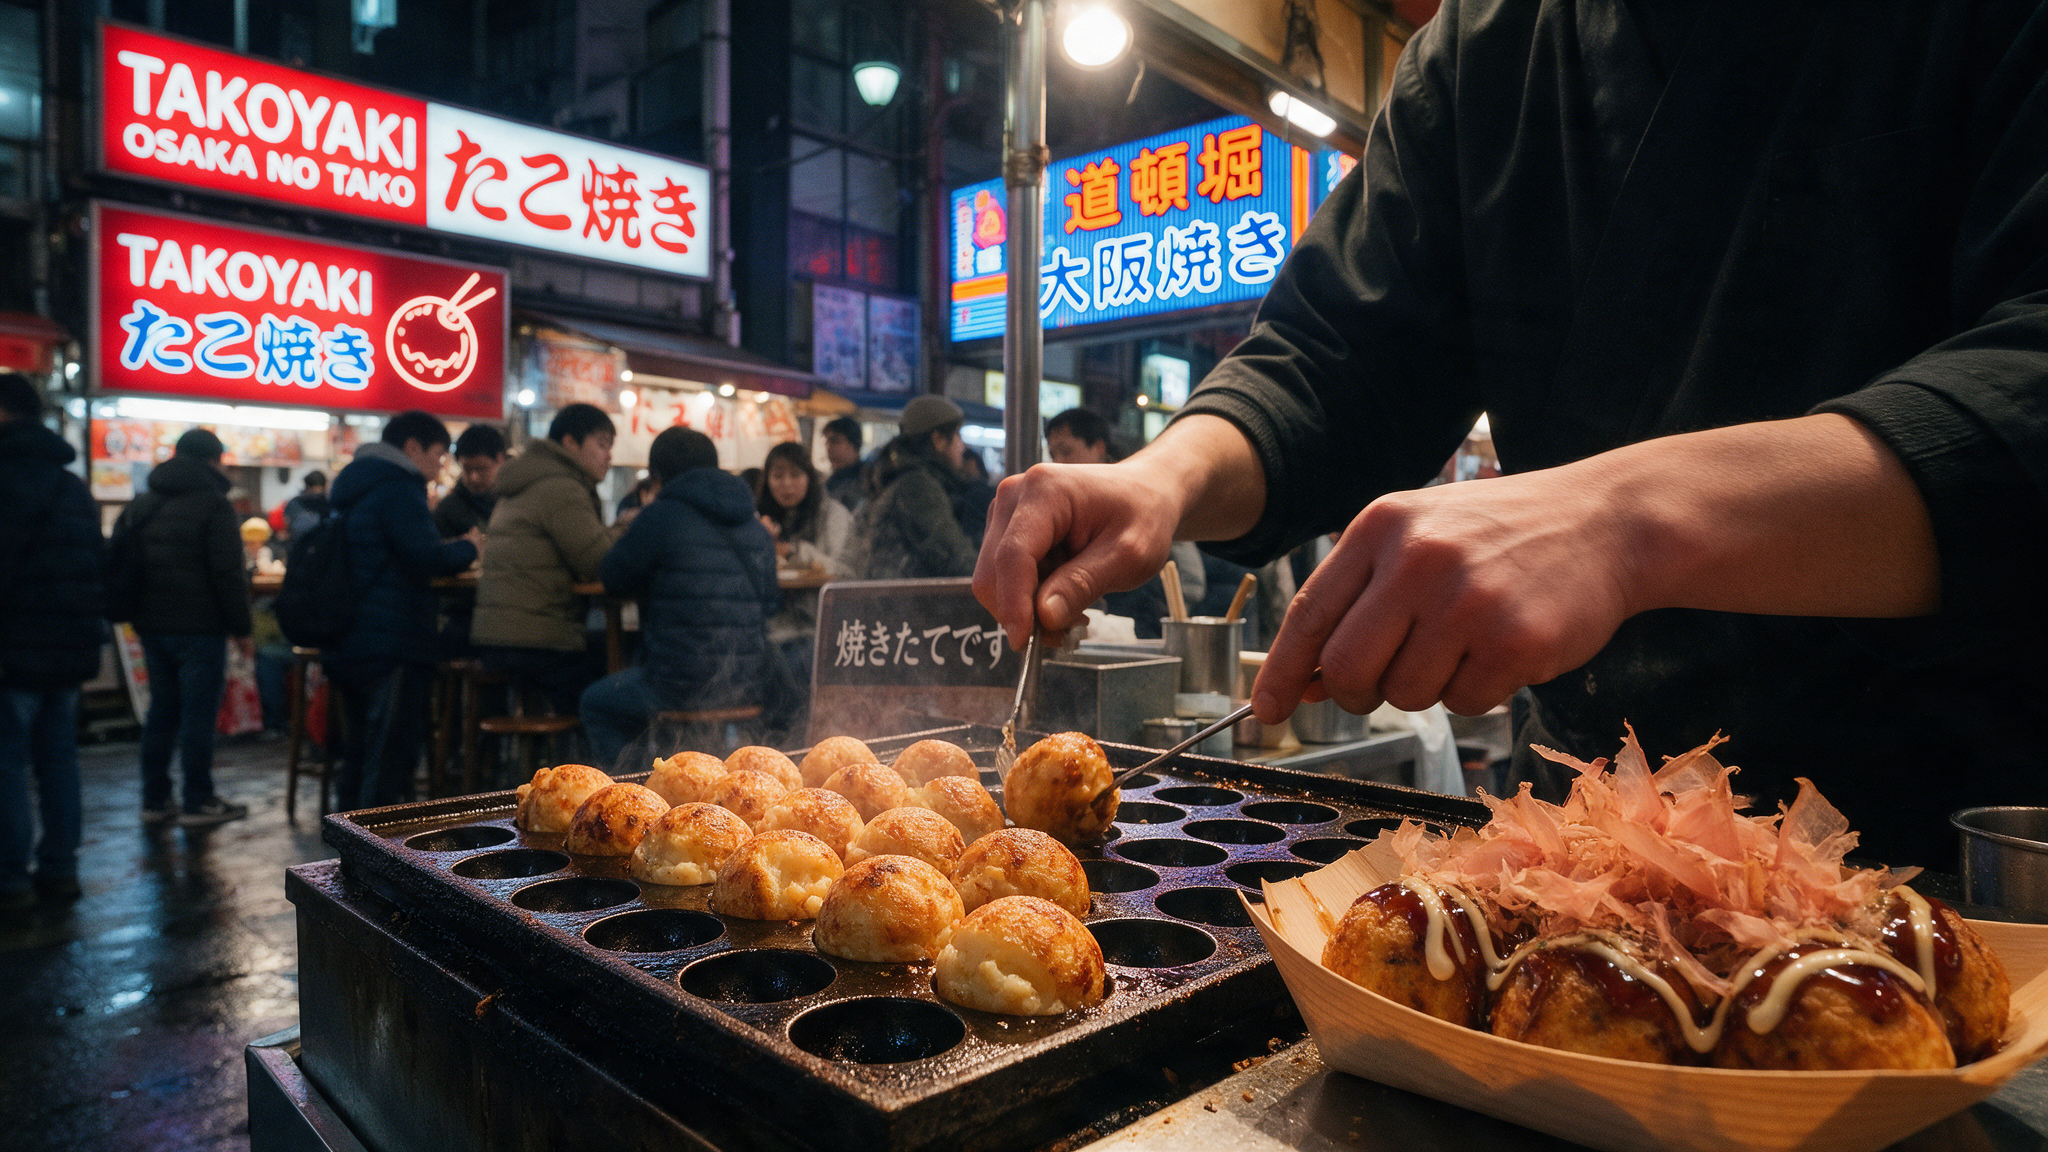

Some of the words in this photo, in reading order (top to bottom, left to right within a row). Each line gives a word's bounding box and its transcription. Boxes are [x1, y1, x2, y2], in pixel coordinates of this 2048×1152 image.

[118, 50, 417, 171] TAKOYAKI
[123, 122, 258, 180] OSAKA
[266, 149, 321, 190] NO
[326, 162, 416, 208] TAKO
[444, 129, 697, 255] たこ焼き
[1065, 124, 1263, 234] 道頓堀
[117, 232, 373, 316] TAKOYAKI
[1040, 210, 1287, 319] 大阪焼き
[119, 299, 375, 391] たこ焼き
[834, 619, 1008, 670] 焼きたてです
